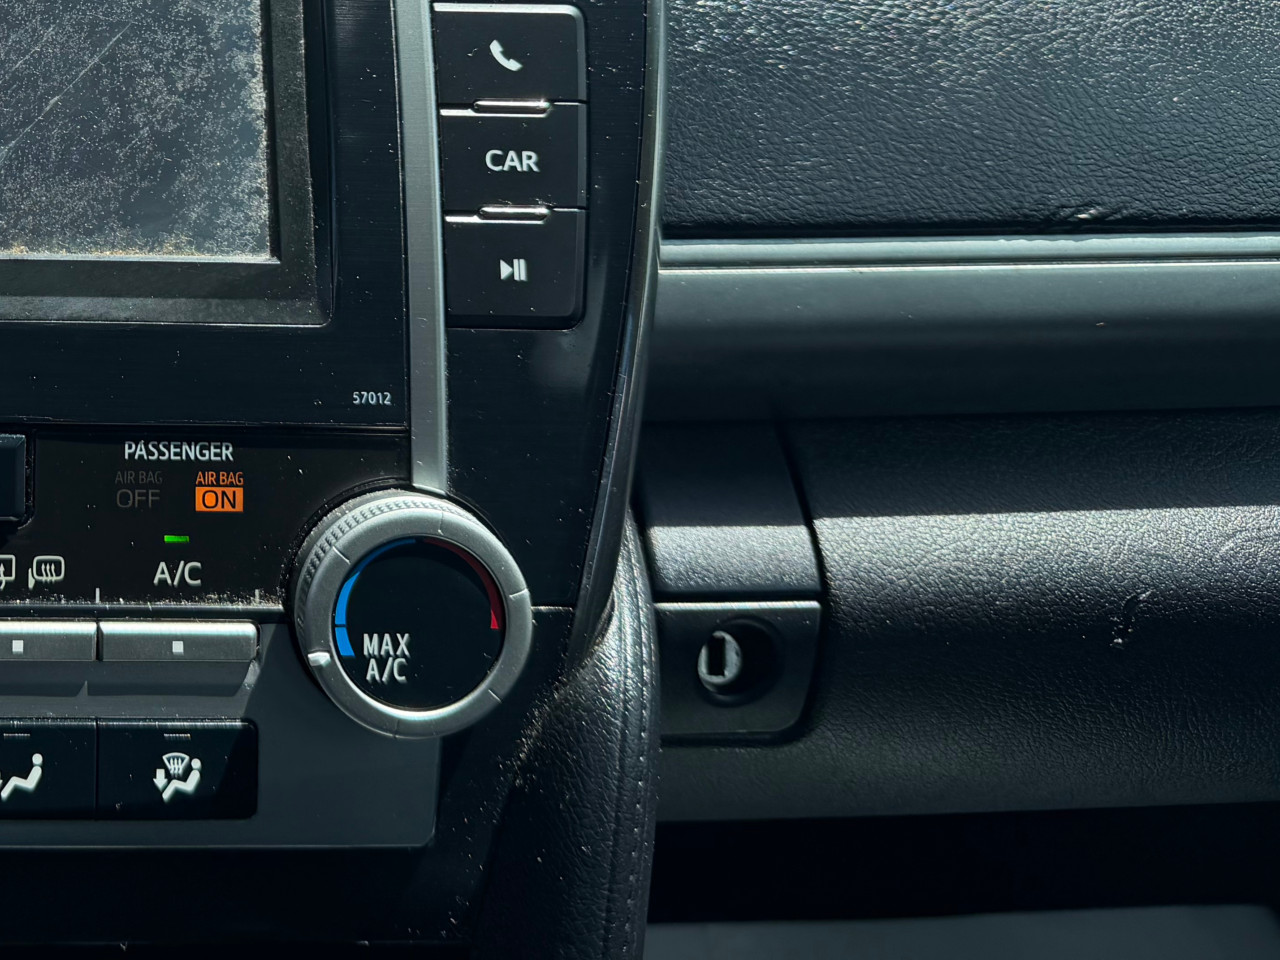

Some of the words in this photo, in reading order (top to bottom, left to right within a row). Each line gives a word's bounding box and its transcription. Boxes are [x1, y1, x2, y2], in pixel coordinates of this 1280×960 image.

[485, 149, 540, 173] CAR
[352, 392, 392, 406] 57012
[124, 441, 234, 461] PASSENGER
[115, 470, 136, 484] AIR
[139, 470, 163, 484] BAG
[195, 471, 217, 486] AIR
[220, 471, 244, 486] BAG
[116, 488, 161, 508] OFF
[202, 490, 236, 509] ON
[153, 560, 202, 587] A/C
[363, 632, 411, 658] MAX
[366, 658, 408, 684] A/C
